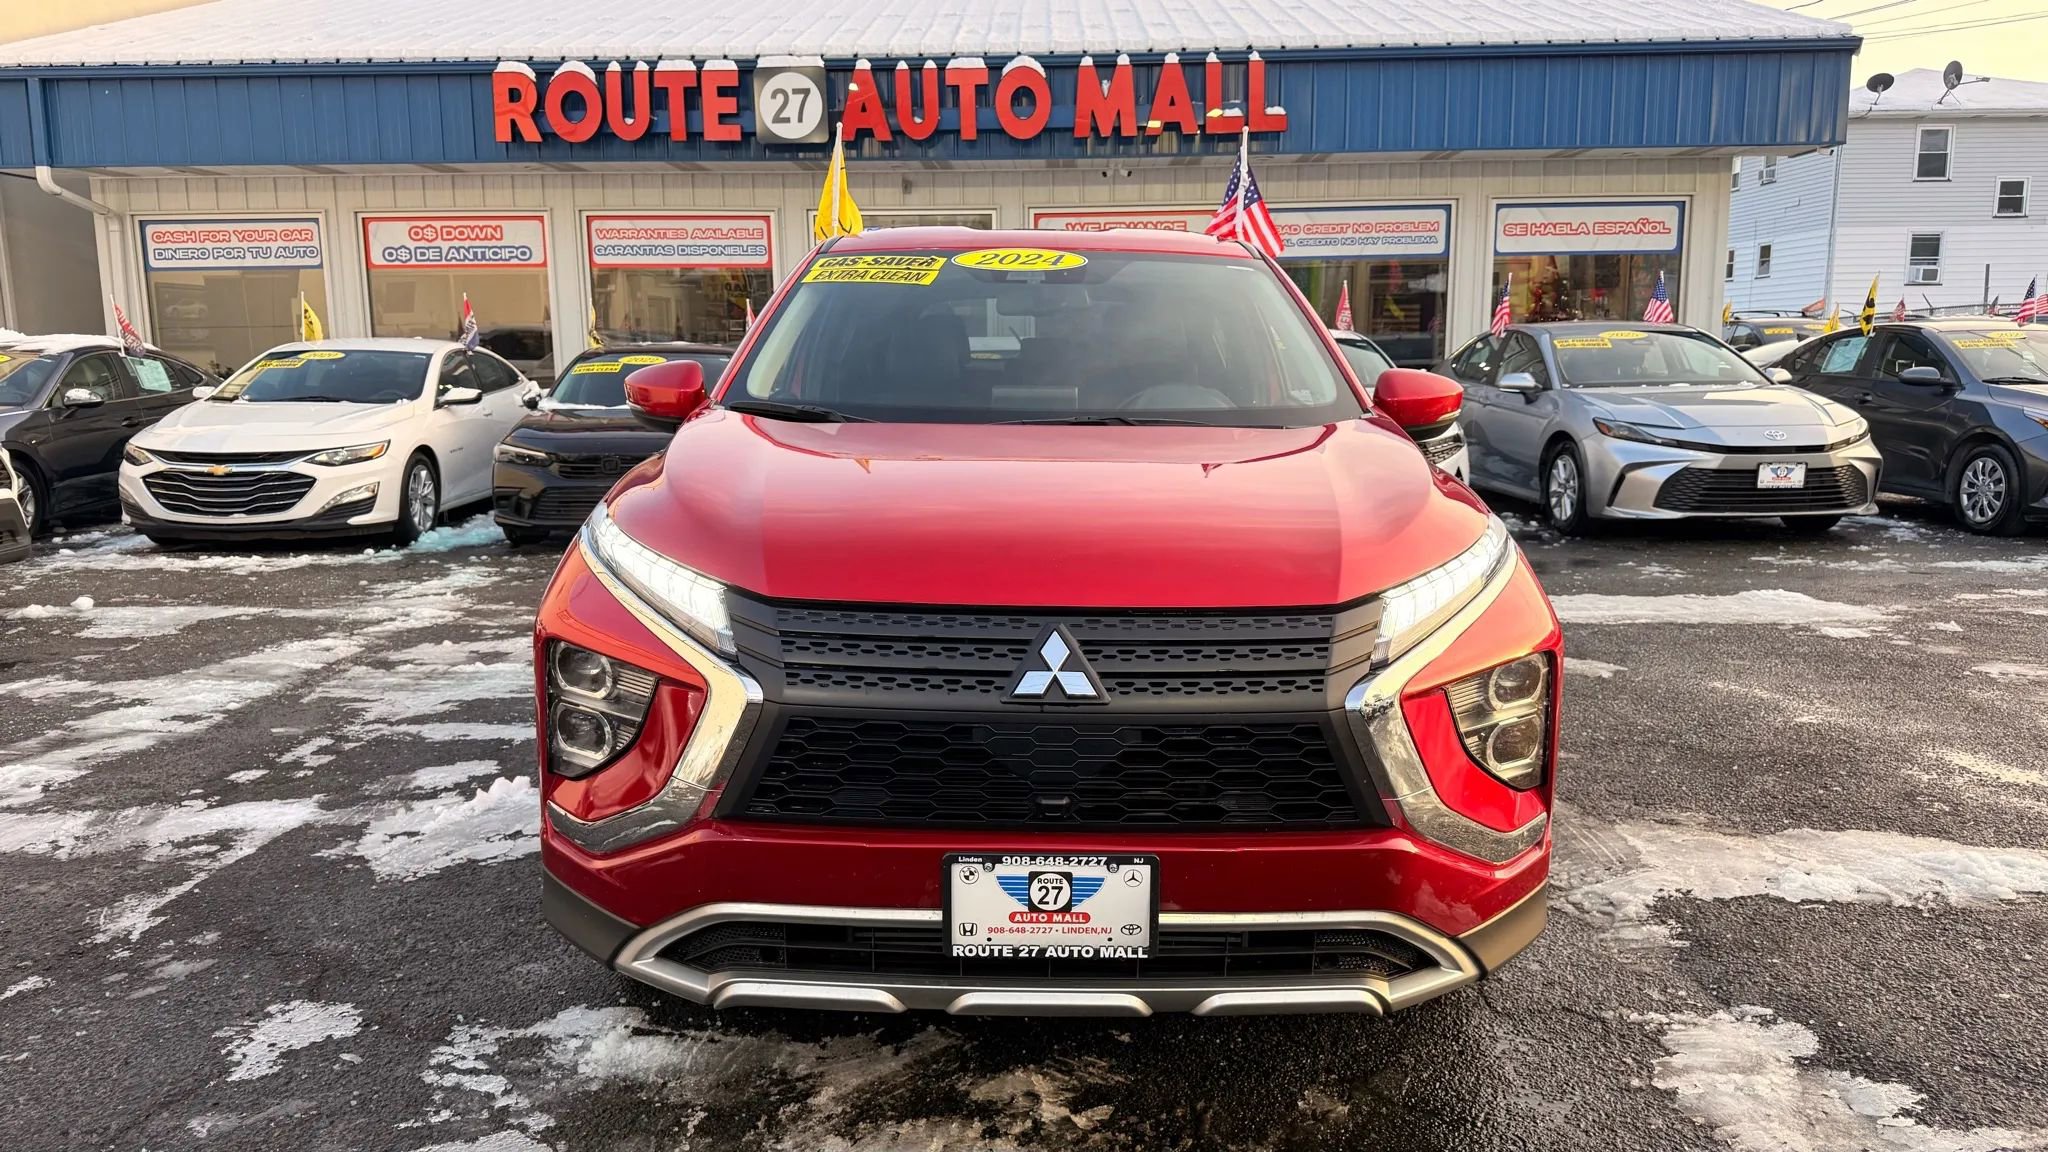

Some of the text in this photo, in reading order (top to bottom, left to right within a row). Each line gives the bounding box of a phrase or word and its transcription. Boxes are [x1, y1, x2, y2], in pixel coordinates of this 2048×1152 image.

[492, 61, 1288, 143] ROUTE 27 AUTO MALL
[440, 225, 503, 241] DOWN
[1303, 223, 1350, 235] CREDIT
[1353, 223, 1373, 234] NO
[1374, 221, 1440, 233] PROBLEM
[1504, 217, 1672, 236] SE HABLA ESPAÑOL
[151, 229, 313, 244] CASH FOR YOUR CAR
[595, 228, 764, 240] WARRANTIES AVAILABLE
[1297, 237, 1340, 247] CREDITO
[1341, 237, 1357, 246] NO
[1358, 236, 1380, 245] HAY
[1381, 235, 1438, 245] PROBLEMA
[154, 246, 319, 261] DINERO POR TU AUTO
[415, 246, 443, 261] DE
[445, 245, 532, 262] ANTICIPO
[594, 244, 767, 256] GARANTIAS DISPONIBLES
[819, 256, 937, 268] GAS-SAVER
[975, 253, 1065, 267] 2024
[812, 270, 930, 281] EXTRA CLEAN
[1001, 856, 1107, 866] 908-648-2727
[1037, 877, 1064, 885] ROUTE
[1037, 886, 1064, 905] 27
[1013, 913, 1086, 923] AUTO MALL
[987, 926, 1053, 935] 908-648-2727
[952, 945, 1148, 959] ROUTE 27 AUTO MALL
